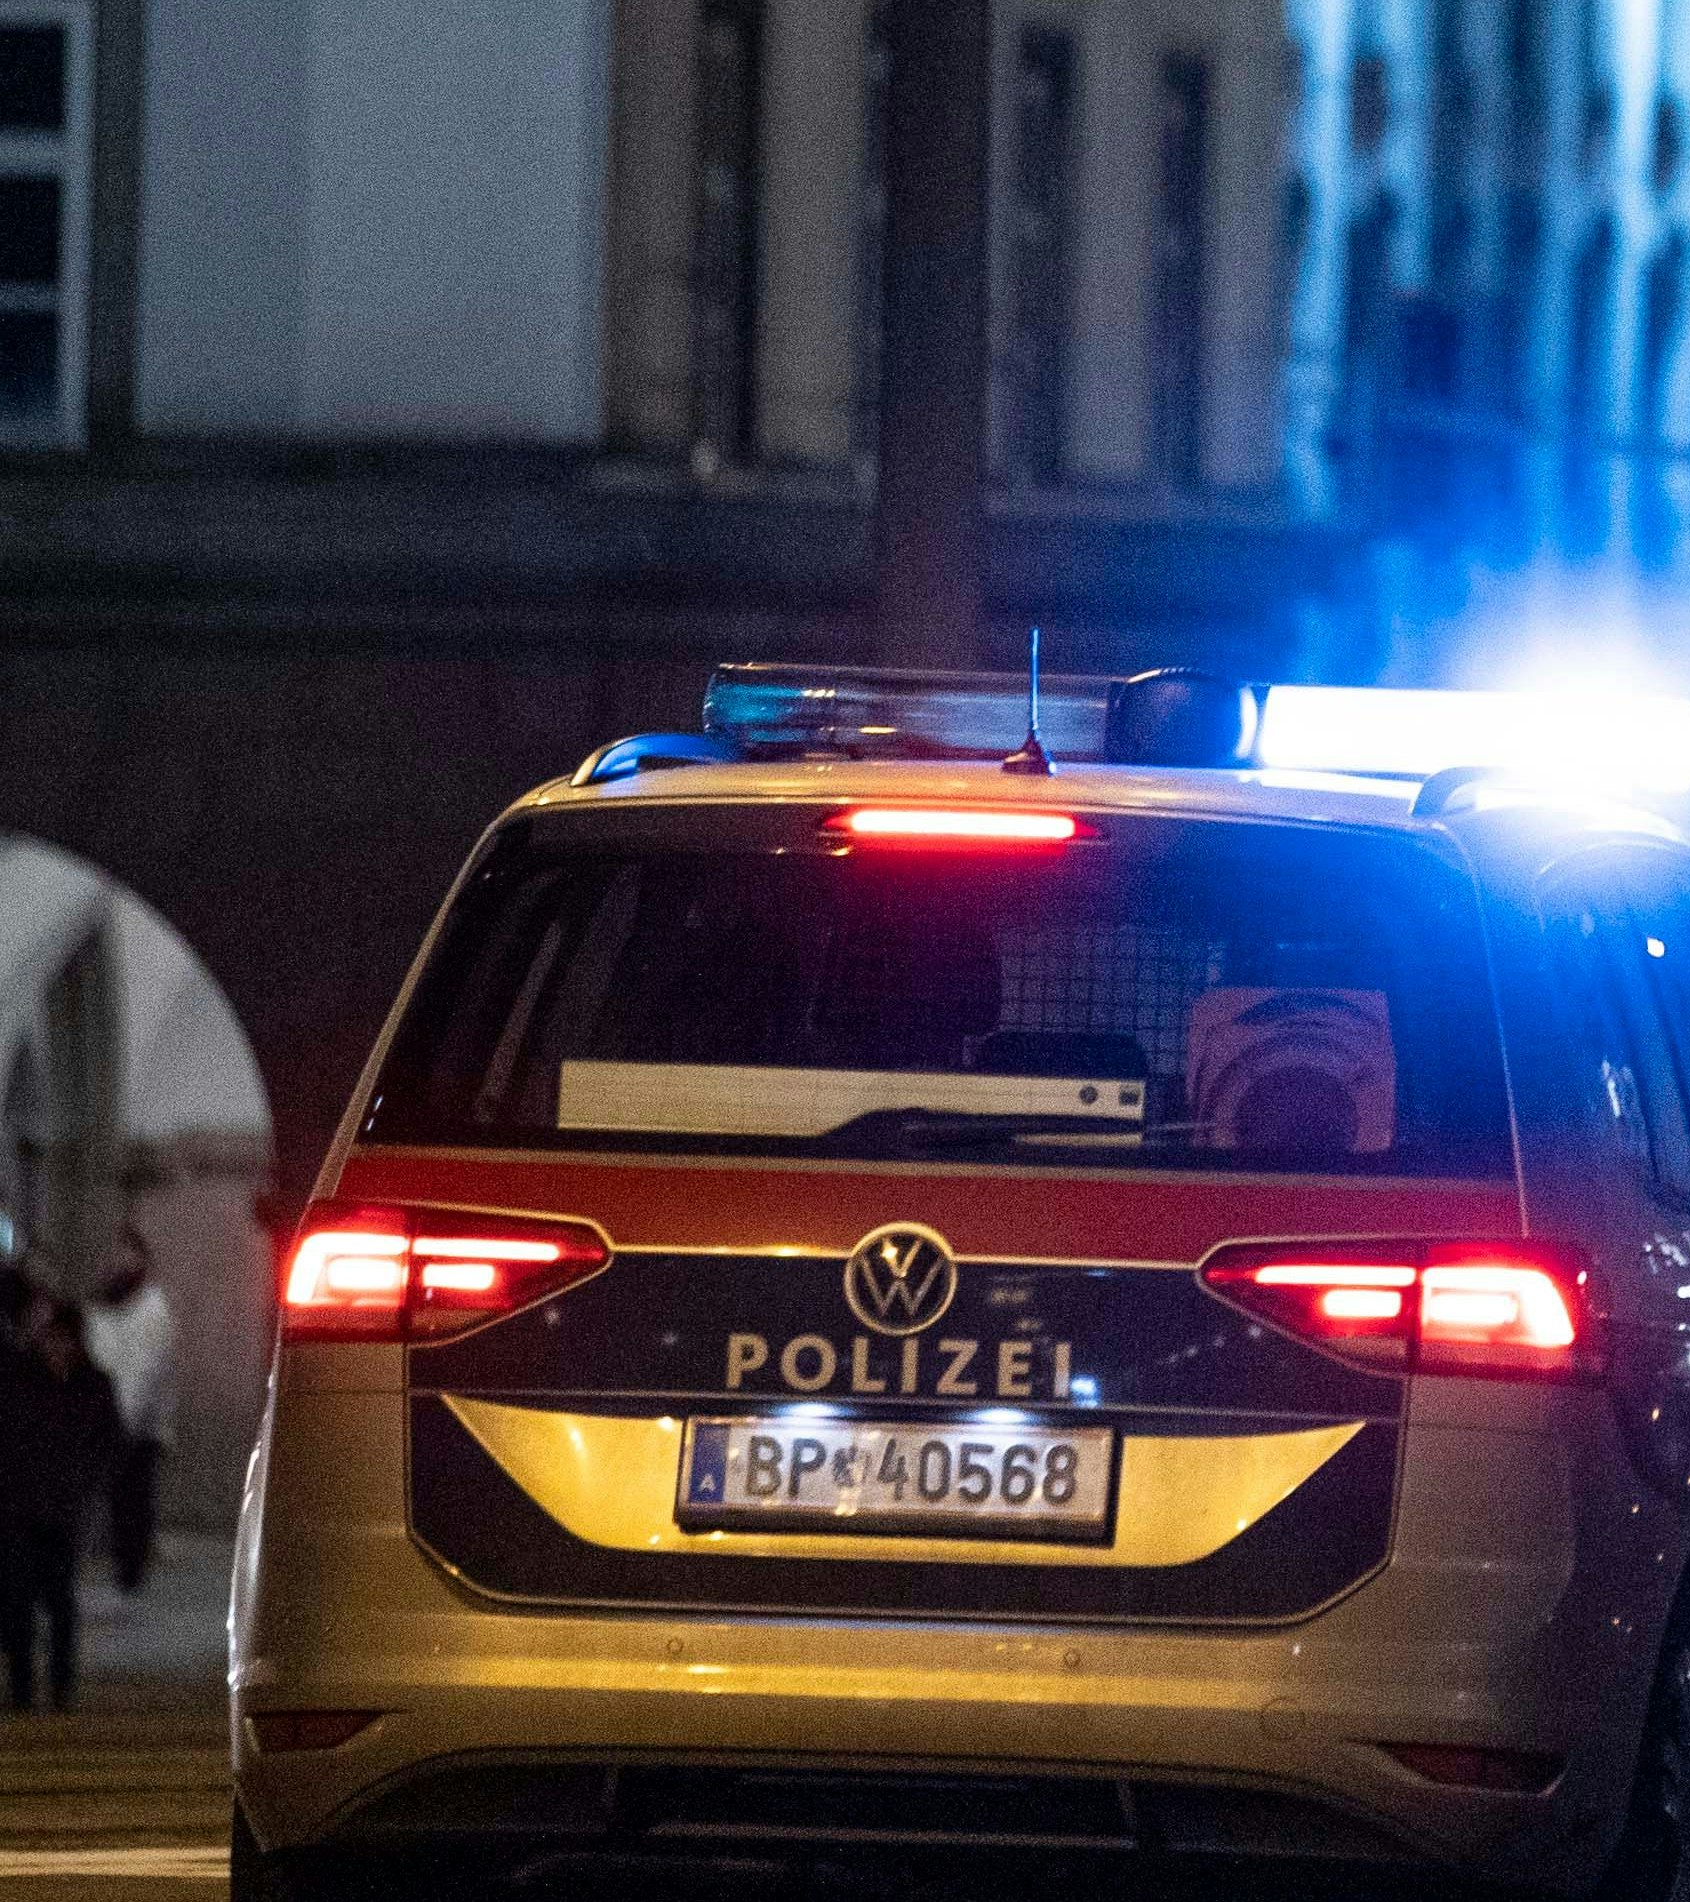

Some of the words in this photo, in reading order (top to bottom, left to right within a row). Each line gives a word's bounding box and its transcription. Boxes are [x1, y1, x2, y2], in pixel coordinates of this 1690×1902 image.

[854, 1231, 948, 1324] VW
[727, 1333, 1071, 1396] POLIZEI
[698, 1473, 716, 1492] A
[744, 1436, 827, 1499] BP
[877, 1438, 1078, 1505] 40568
